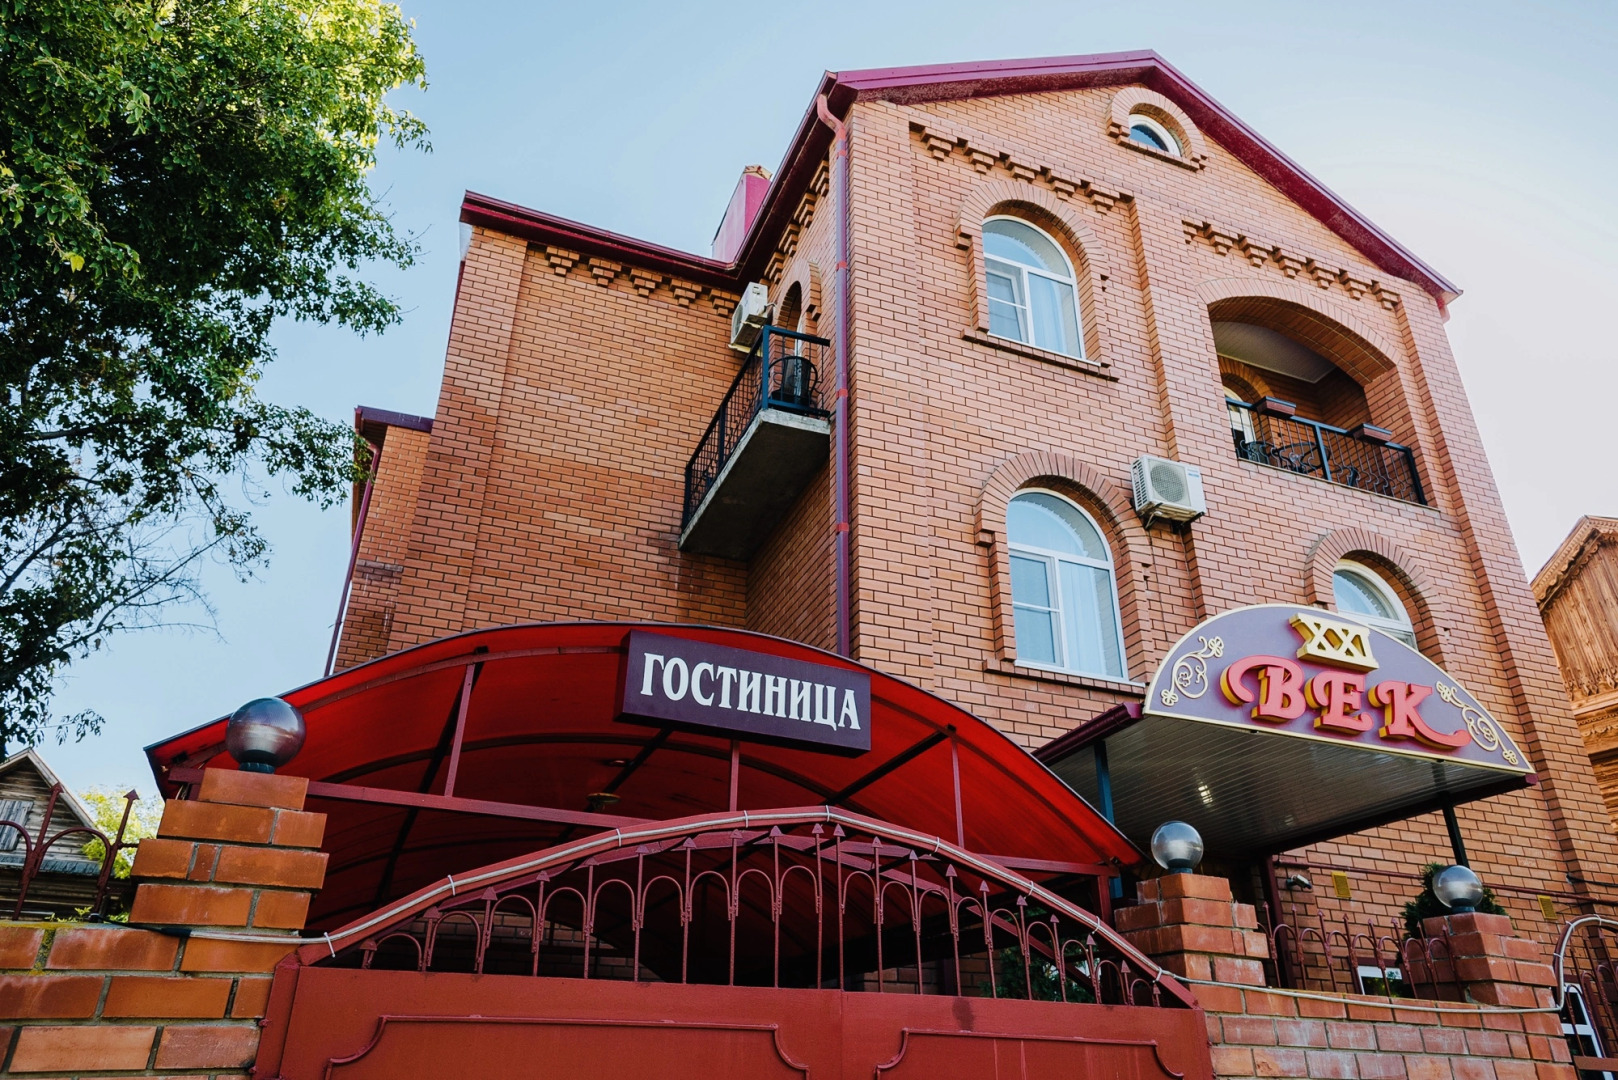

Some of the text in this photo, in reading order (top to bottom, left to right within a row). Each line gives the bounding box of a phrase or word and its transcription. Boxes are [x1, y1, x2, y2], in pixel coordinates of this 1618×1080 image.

[1289, 612, 1379, 672] XXI
[640, 652, 861, 731] ГОСТИНИЦА
[1221, 654, 1472, 750] ВЕК
